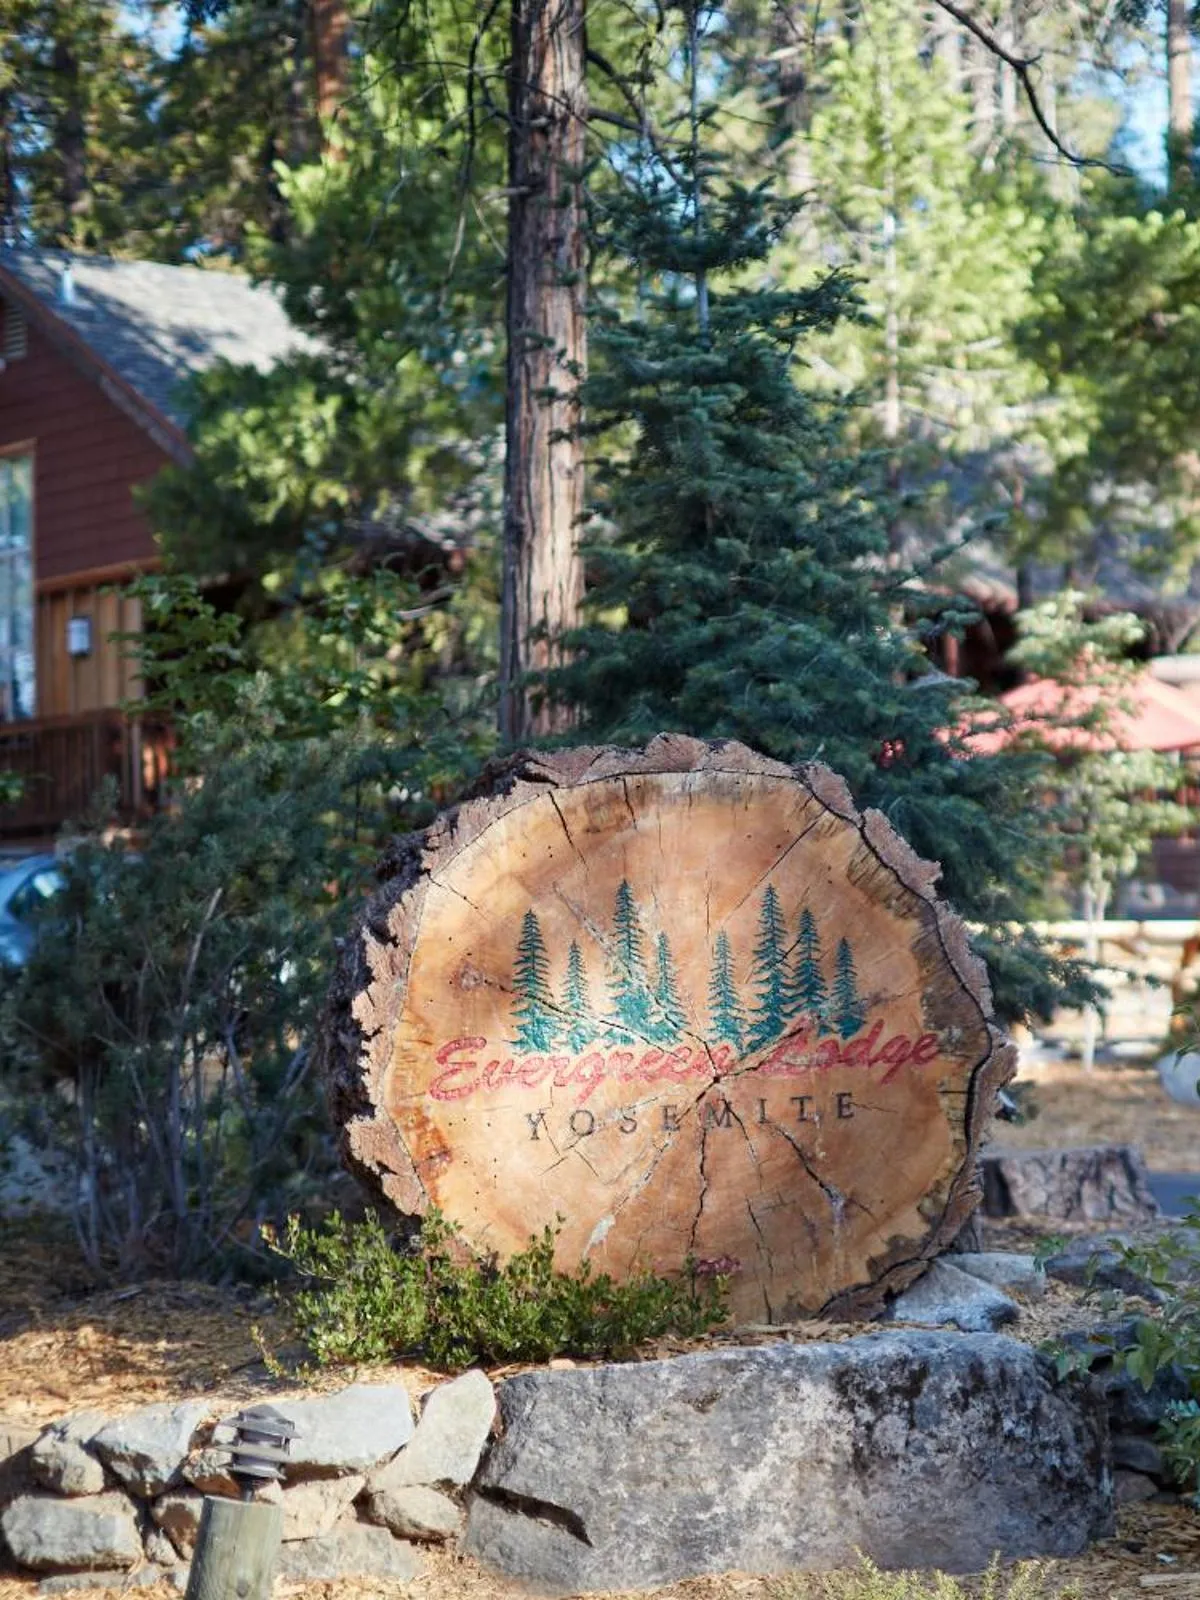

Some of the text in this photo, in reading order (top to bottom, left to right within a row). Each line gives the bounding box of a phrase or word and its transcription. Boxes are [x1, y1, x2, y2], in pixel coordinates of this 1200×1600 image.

[428, 1014, 941, 1104] Evergreen Lodge
[525, 1092, 855, 1142] YOSEMITE
